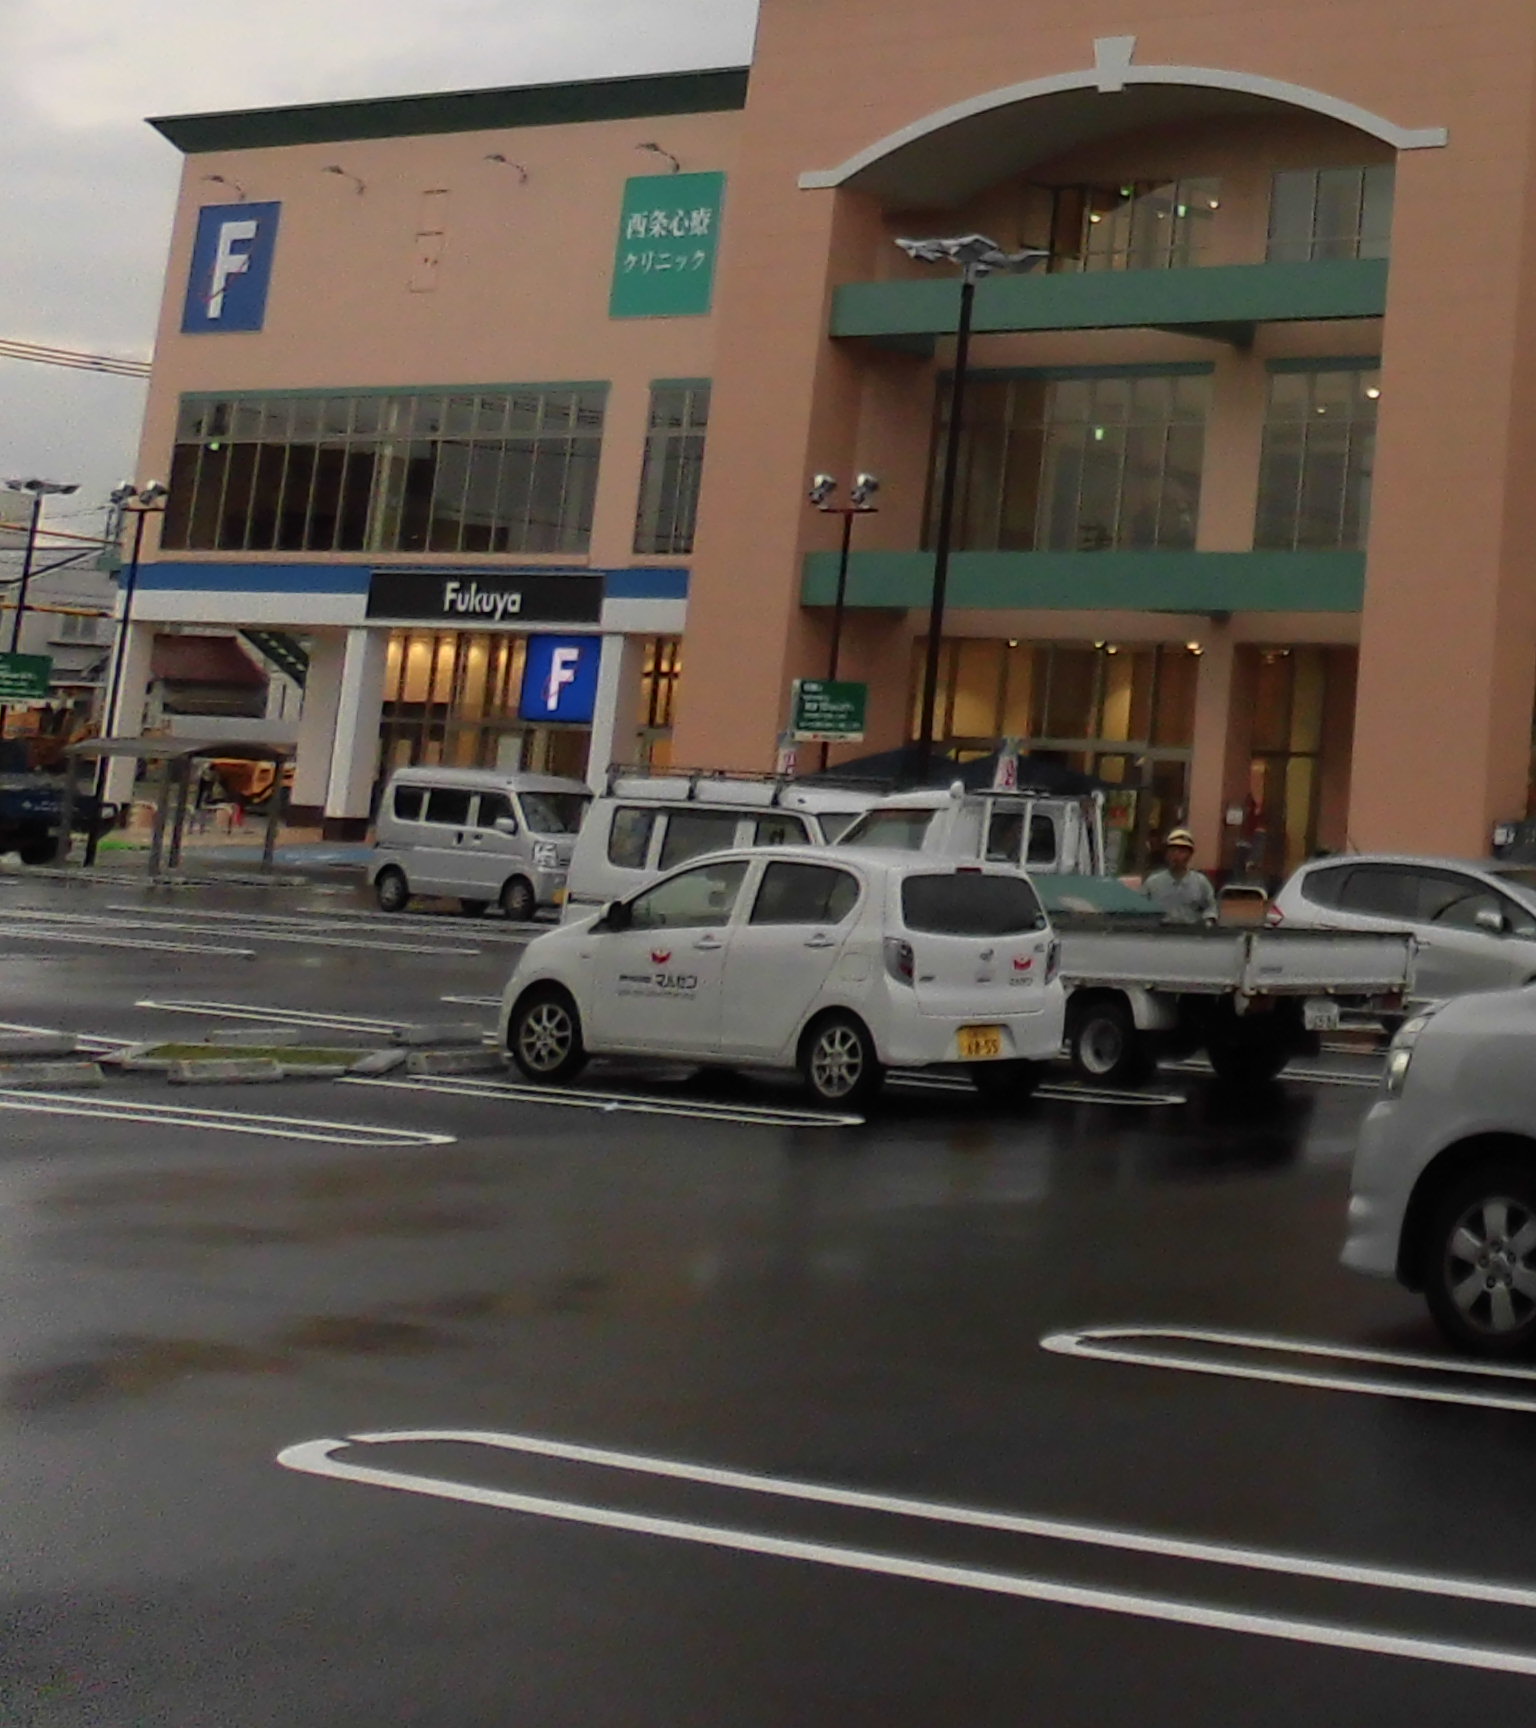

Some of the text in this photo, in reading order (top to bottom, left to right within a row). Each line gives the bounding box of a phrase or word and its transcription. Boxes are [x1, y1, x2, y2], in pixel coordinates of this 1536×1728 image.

[206, 220, 258, 319] F
[623, 249, 706, 274] クリニック
[443, 580, 523, 621] Fukuya
[546, 646, 581, 711] F
